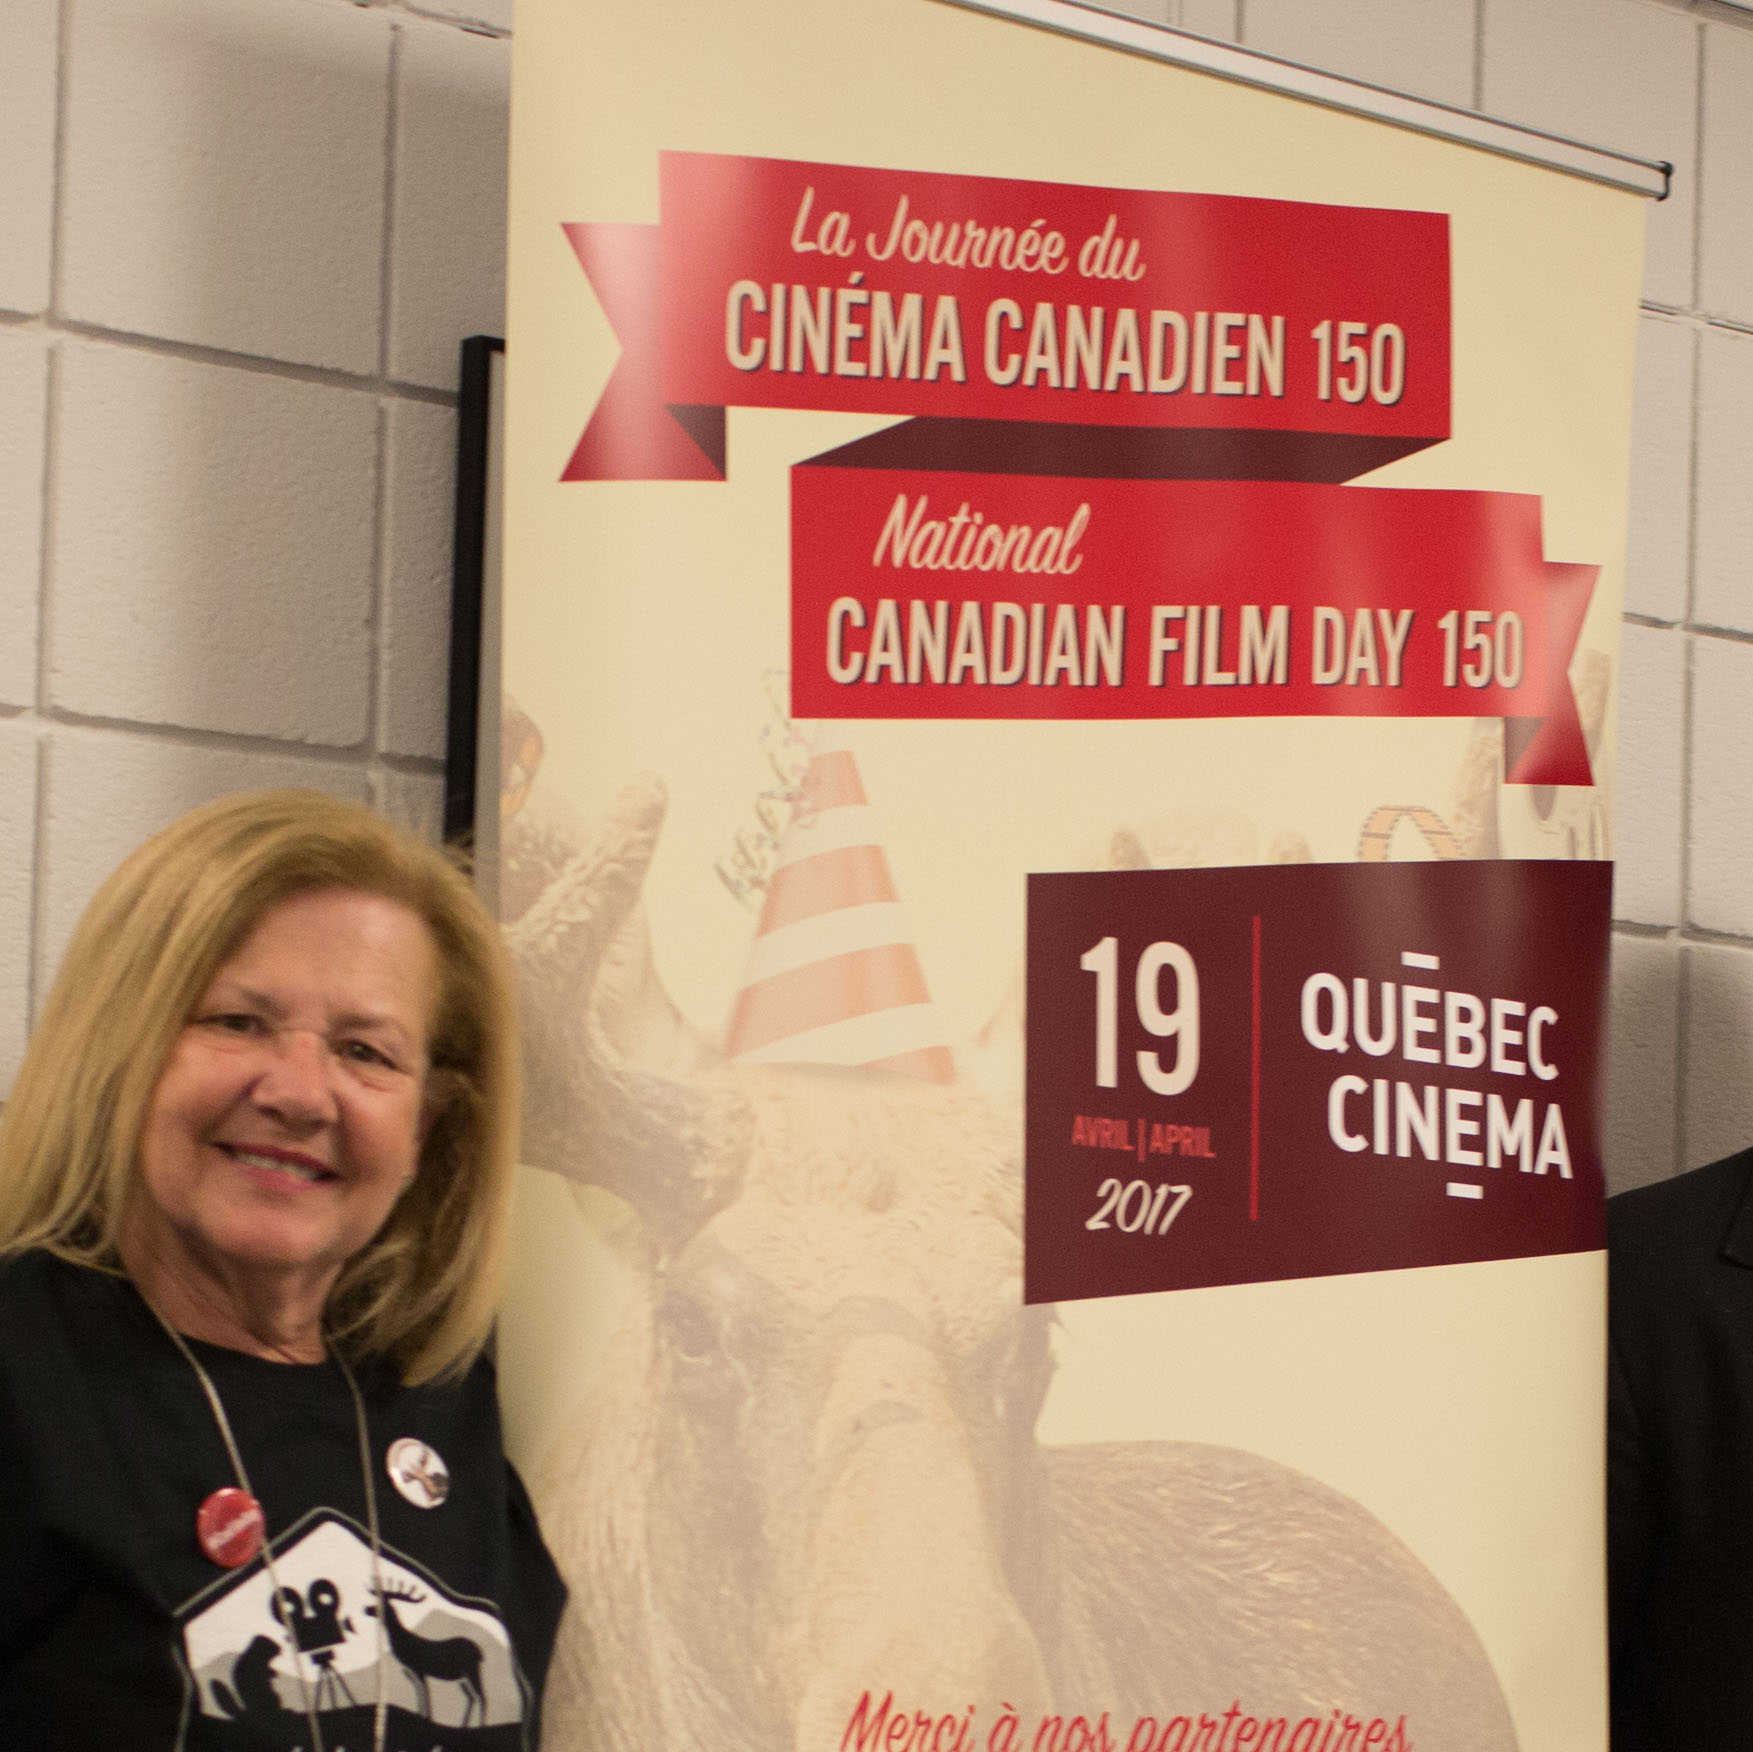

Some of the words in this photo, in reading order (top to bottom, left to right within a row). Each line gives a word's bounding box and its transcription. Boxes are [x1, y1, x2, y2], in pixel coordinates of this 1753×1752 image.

[792, 187, 853, 256] La
[868, 194, 1067, 275] Journée
[1077, 214, 1145, 283] du
[724, 273, 967, 385] CINÉMA
[983, 299, 1285, 399] CANADIEN
[1311, 320, 1407, 406] 150
[872, 493, 1091, 576] National
[826, 597, 1125, 689] CANADIAN
[1149, 603, 1290, 689] FILM
[1312, 607, 1415, 689] DAY
[1438, 610, 1524, 691] 150
[1080, 936, 1201, 1096] 19
[1084, 1178, 1193, 1236] 2017
